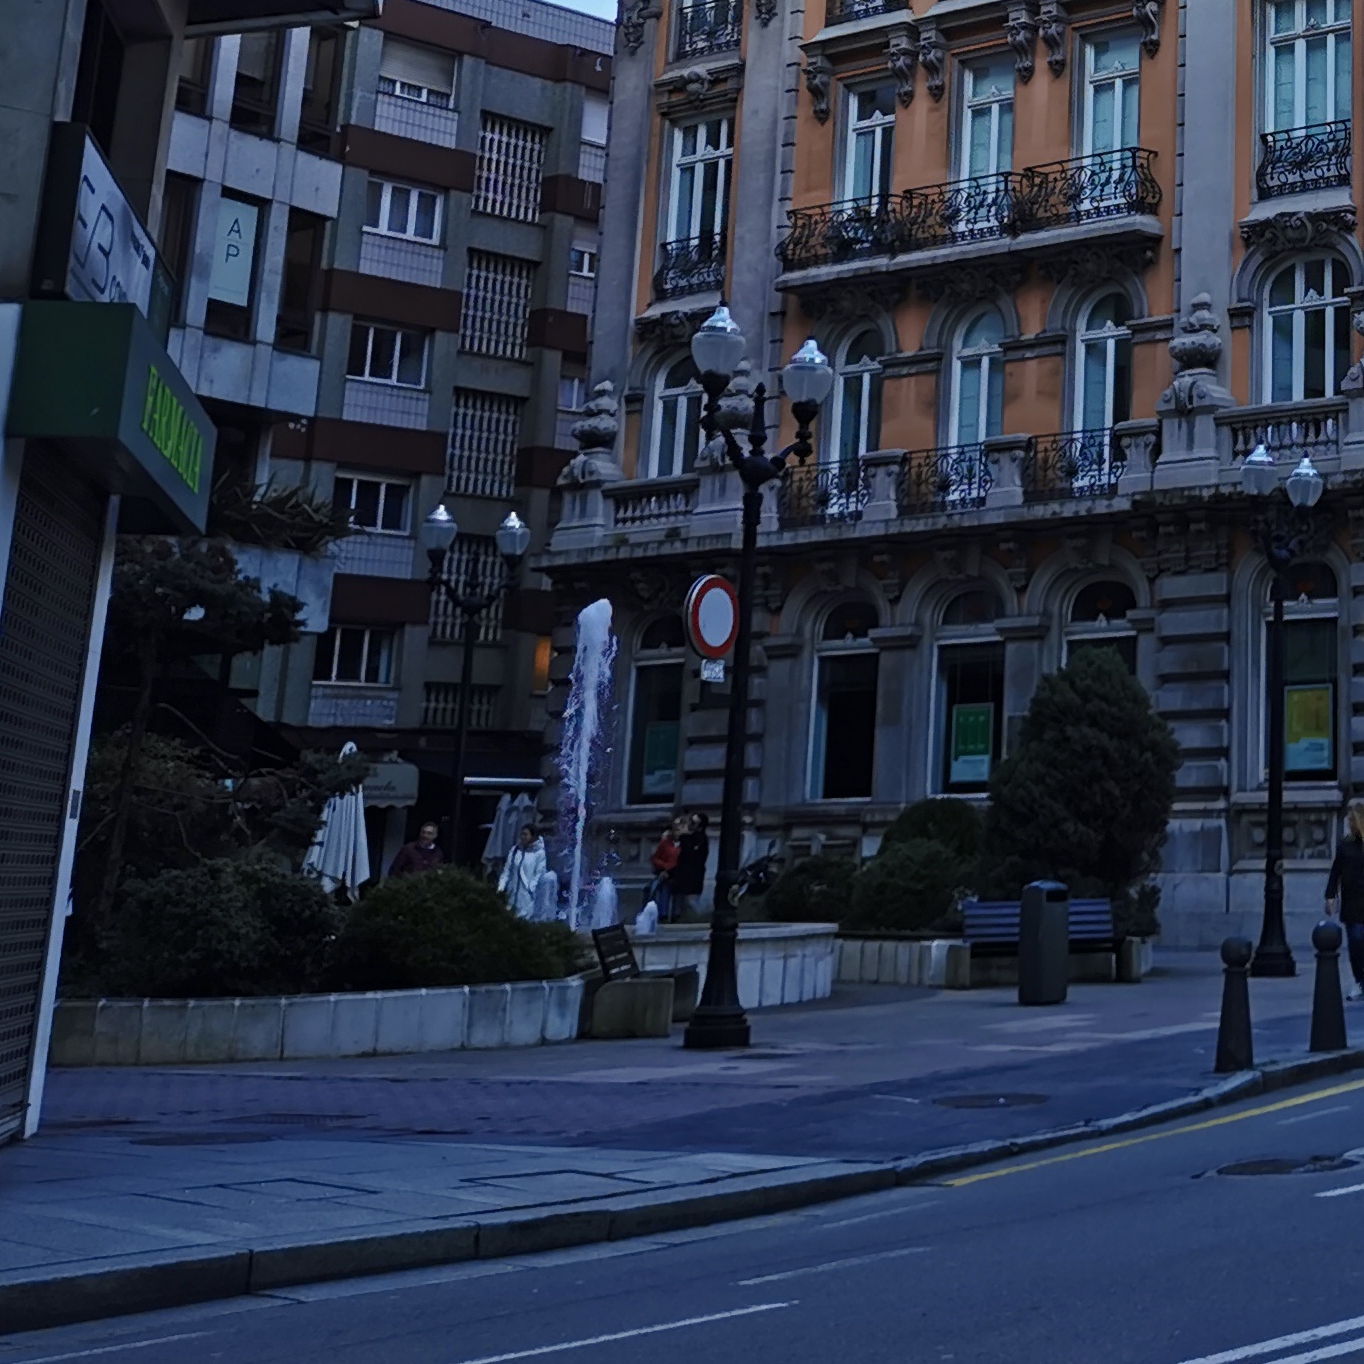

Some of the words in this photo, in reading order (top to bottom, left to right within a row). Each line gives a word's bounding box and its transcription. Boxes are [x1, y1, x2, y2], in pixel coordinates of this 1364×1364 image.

[226, 217, 243, 240] A
[224, 243, 241, 264] P
[142, 363, 203, 495] FARMACIA
